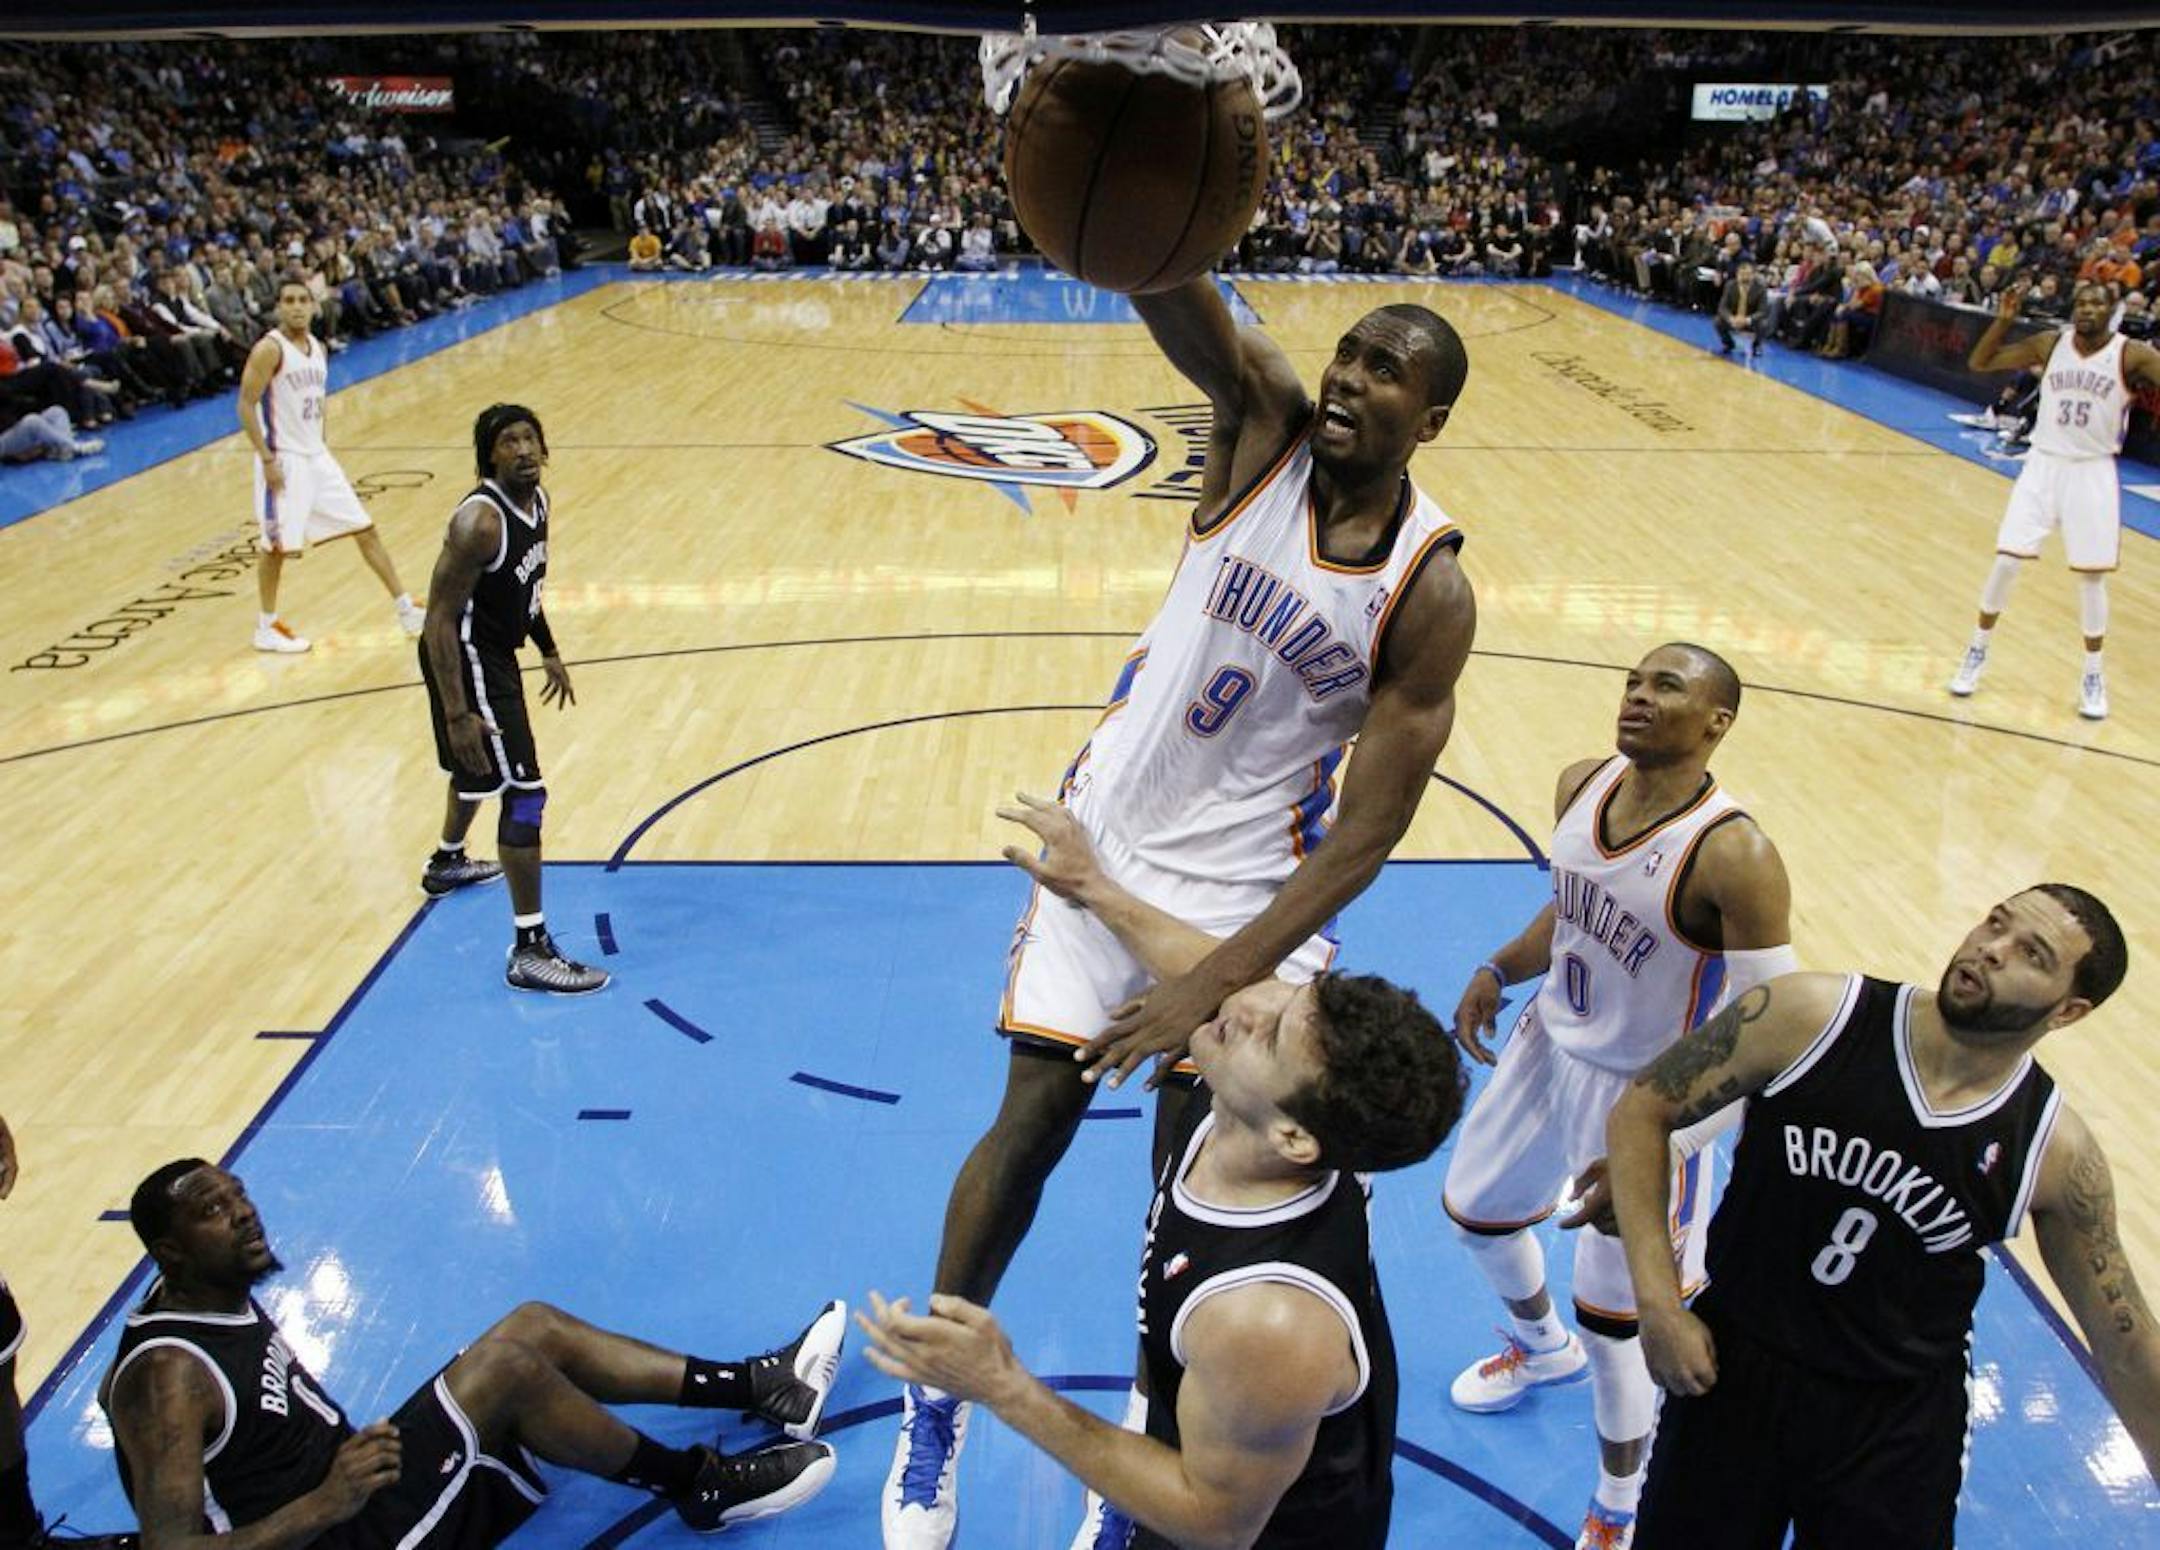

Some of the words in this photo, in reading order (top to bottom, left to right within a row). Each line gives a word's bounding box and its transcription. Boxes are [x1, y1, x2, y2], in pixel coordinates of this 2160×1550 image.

[2049, 370, 2115, 400] THUNDER
[2058, 400, 2091, 429] 35
[1203, 554, 1370, 703] THUNDER
[1186, 664, 1256, 738] 9
[1566, 952, 1591, 1017] 0
[1784, 1124, 1974, 1254] BROOKLYN
[1811, 1206, 1879, 1286] 8
[290, 1374, 340, 1427] 0
